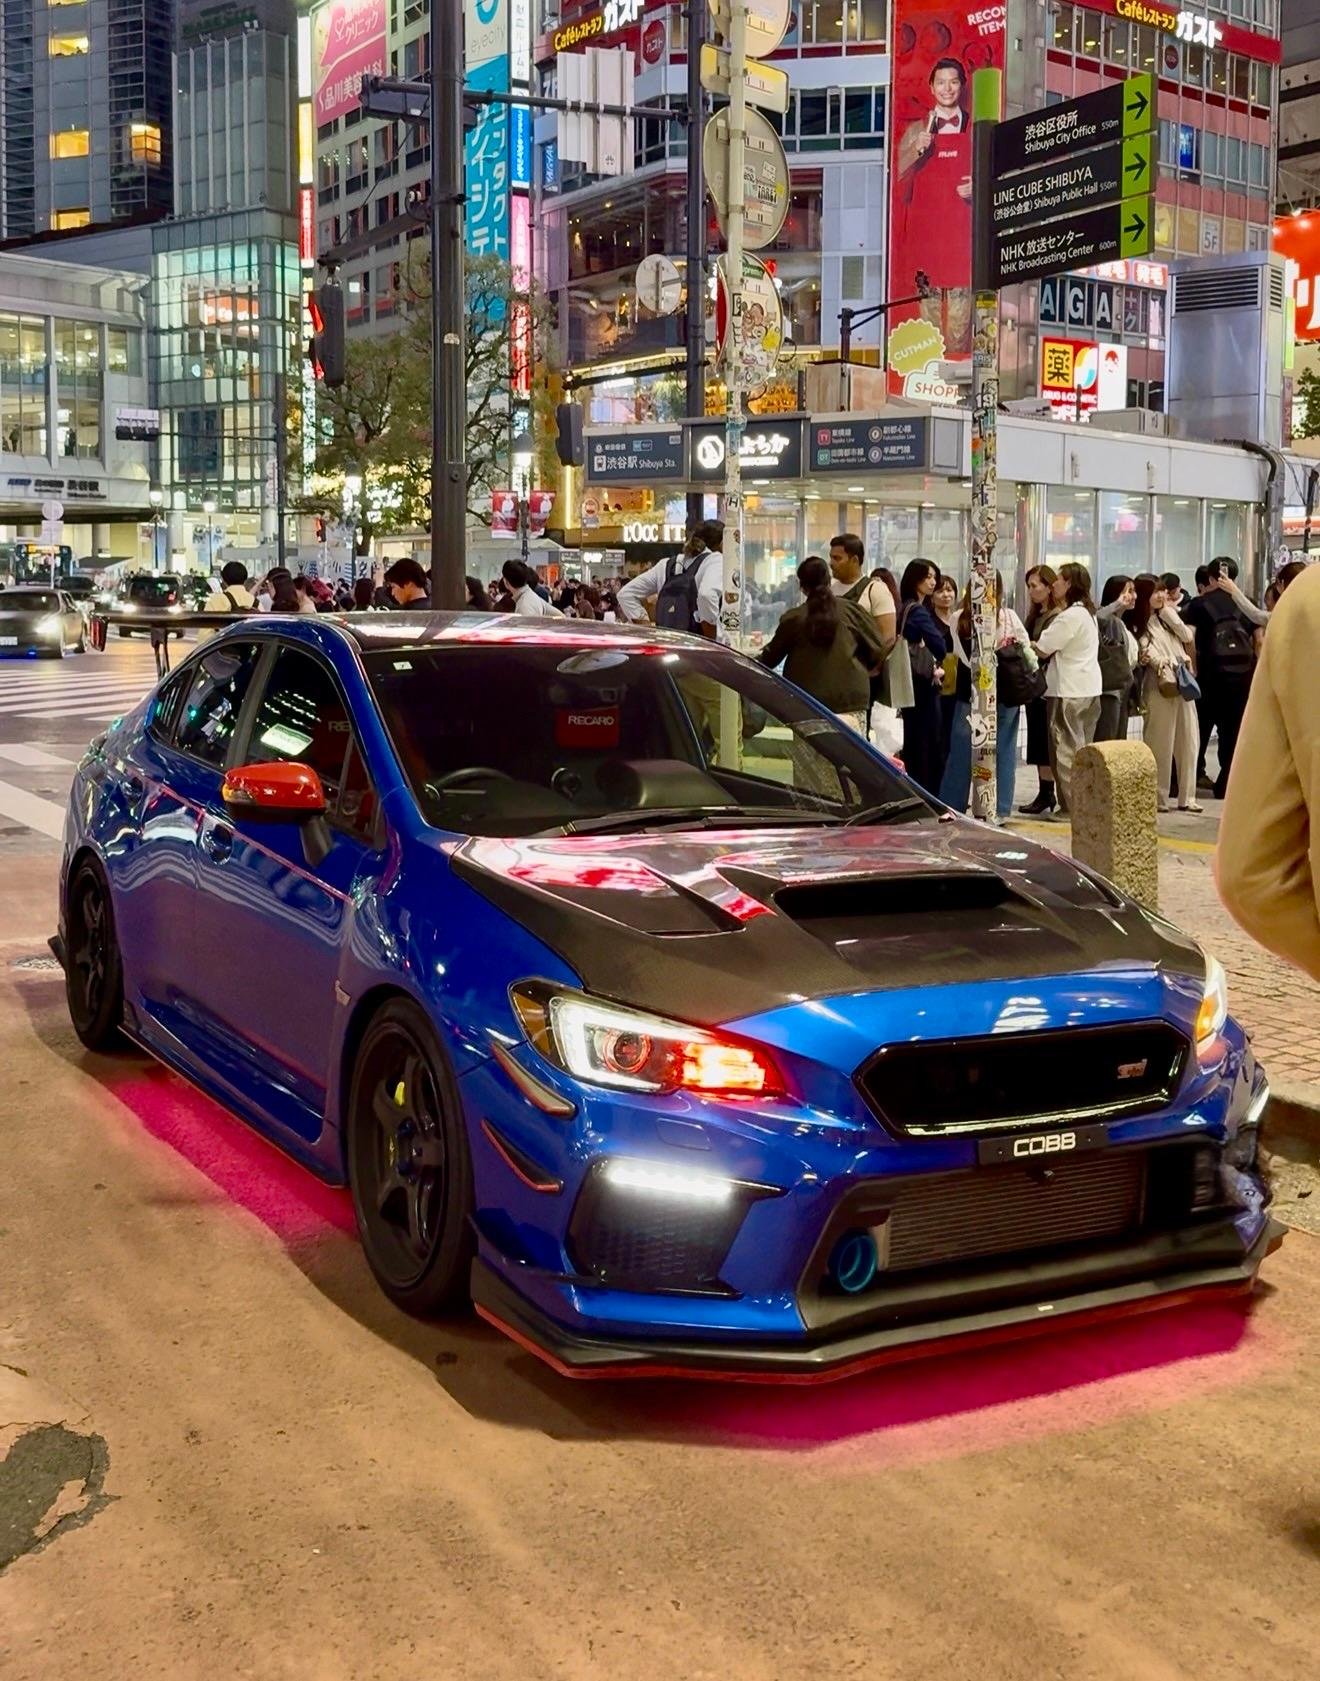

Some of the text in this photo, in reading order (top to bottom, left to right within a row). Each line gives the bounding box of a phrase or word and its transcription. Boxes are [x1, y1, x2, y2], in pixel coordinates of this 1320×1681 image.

[1176, 11, 1223, 48] ガスト
[1024, 119, 1119, 154] Shibuya City Office 550m
[1025, 110, 1079, 141] 渋谷区役所
[993, 166, 1093, 206] LINE CUBE SHIBUYA
[1034, 192, 1061, 209] Shibuya
[1062, 186, 1083, 202] Public
[1084, 182, 1099, 196] Hall
[1100, 181, 1118, 192] 550m
[1000, 230, 1085, 262] NHK 放送センター
[1000, 262, 1018, 275] NHK
[1018, 249, 1067, 271] Broadcasting
[1067, 243, 1095, 259] Center
[1099, 240, 1117, 251] 600m
[1040, 283, 1111, 323] AGA
[894, 336, 938, 361] CUTMAN
[1048, 348, 1070, 383] 薬
[607, 456, 638, 469] 渋谷駅
[639, 458, 663, 470] Shibuya
[567, 715, 615, 726] RECARO
[1013, 1132, 1077, 1157] COBB
